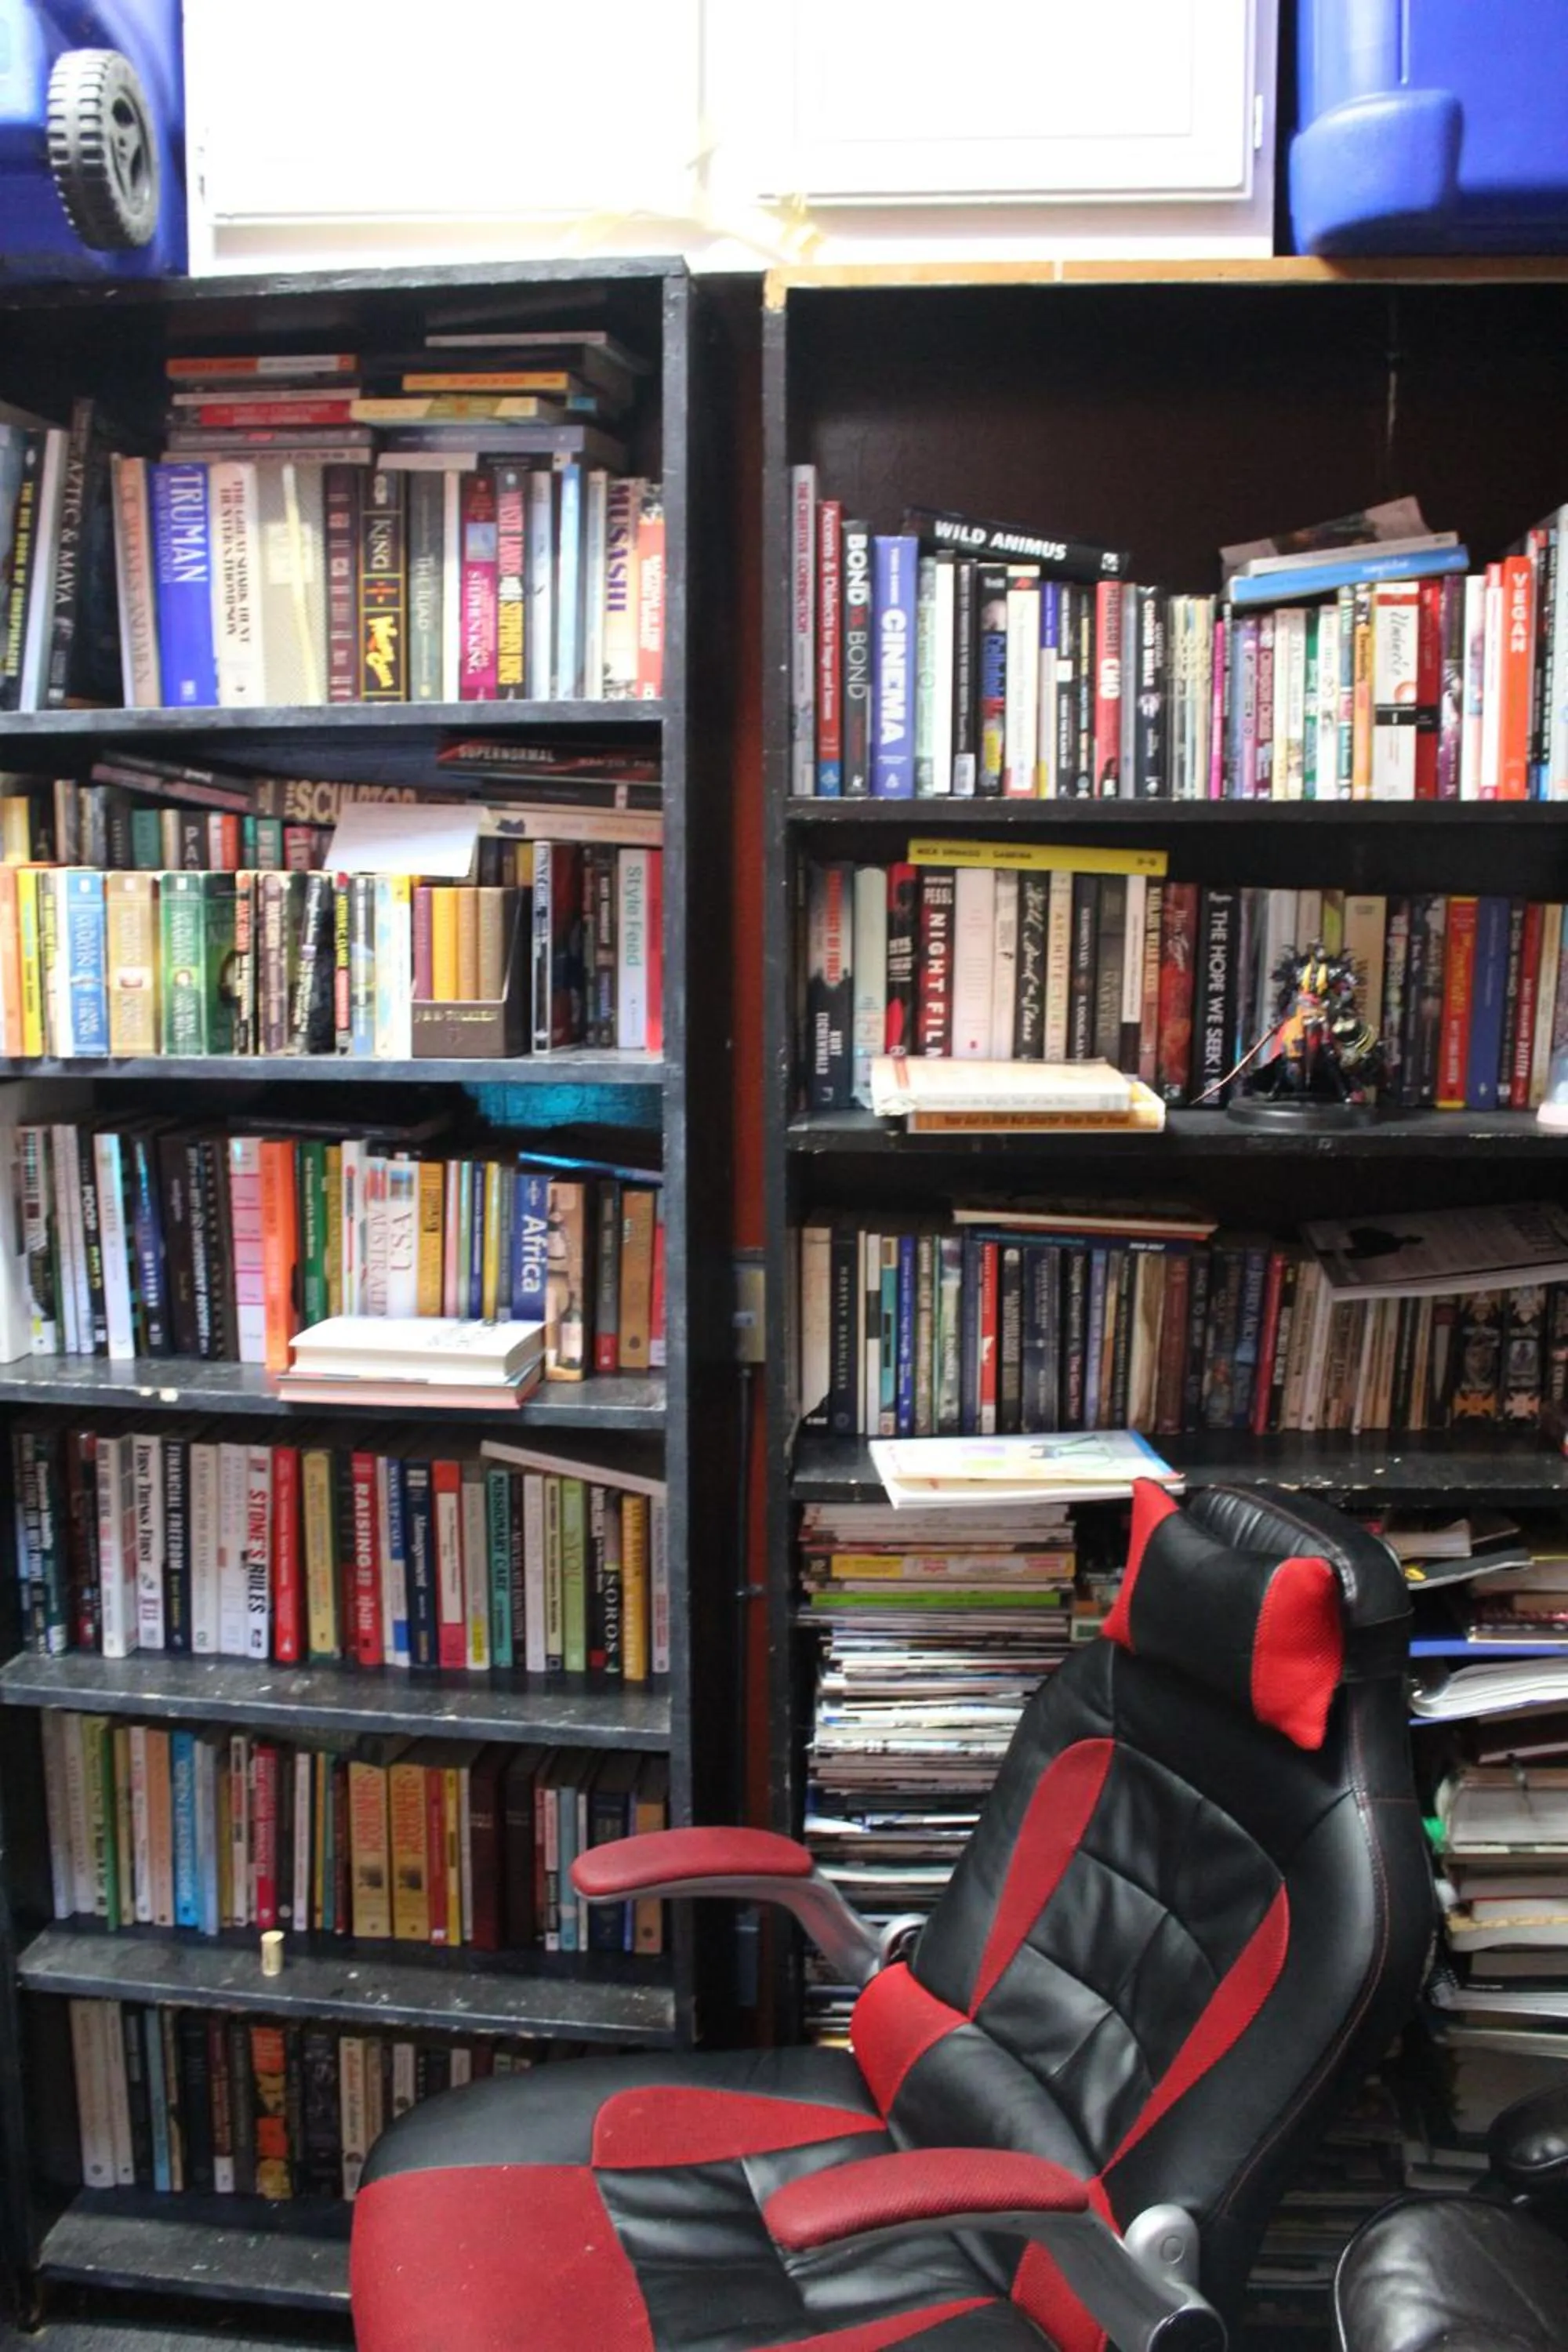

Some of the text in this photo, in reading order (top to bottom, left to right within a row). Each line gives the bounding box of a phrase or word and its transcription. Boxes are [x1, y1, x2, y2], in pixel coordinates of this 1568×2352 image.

[20, 508, 31, 528] BIG
[21, 482, 34, 503] THE
[169, 472, 207, 583] TRUMAN
[15, 533, 31, 566] BOOK
[55, 459, 84, 604] AZTEC & MAYA
[220, 488, 237, 635] HUNTER THOMPSON
[233, 481, 251, 644] THE GREAT SHARK HUNT
[499, 492, 523, 575] WASTE LANDS
[607, 485, 631, 612] MUSASHI
[797, 481, 808, 633] THE CREATIVE CONNECTION
[823, 507, 837, 557] Accents
[824, 561, 836, 572] &
[935, 521, 1067, 561] WILD ANIMUS
[14, 569, 27, 584] OF
[416, 556, 435, 630] THE ILIAD
[823, 576, 837, 627] Dialects
[848, 534, 868, 605] BOND
[466, 571, 483, 674] STEPHEN KING
[499, 602, 523, 684] STEPHEN KING
[1142, 600, 1155, 687] CHORD BIBLE
[1511, 572, 1528, 653] VEGAN
[822, 644, 833, 669] Stage
[824, 671, 833, 688] and
[848, 630, 867, 700] BOND
[880, 608, 907, 746] CINEMA
[1100, 659, 1120, 699] CHO
[459, 745, 556, 763] SUPERNORMAL
[624, 866, 643, 967] Style Feed
[827, 938, 841, 950] OF
[1146, 886, 1161, 929] NAVAJOS
[826, 952, 841, 985] FOOLS
[927, 912, 947, 993] NIGHT
[1146, 931, 1160, 961] WEAR
[1205, 910, 1228, 1066] THE HOPE WE SEEK
[815, 1011, 829, 1076] EICHENWALD
[829, 1029, 843, 1057] KURT
[1515, 1041, 1530, 1078] DEXTER
[82, 1185, 101, 1290] POOP GOLD
[389, 1211, 412, 1272] USA
[521, 1214, 548, 1294] Africa
[837, 1265, 849, 1390] MOSTLY HARMLESS
[1070, 1256, 1083, 1338] Douglas Coupland
[1245, 1270, 1264, 1312] JEFFREY
[945, 1338, 956, 1380] RUNNER
[1069, 1374, 1079, 1396] Gum
[1071, 1355, 1080, 1372] The
[136, 1444, 154, 1564] FIRST THINGS FIRST
[167, 1445, 184, 1569] FINANCIAL FREEDOM
[389, 1466, 399, 1498] WAKE
[248, 1490, 267, 1614] STONE'S RULES
[355, 1483, 371, 1568] RAISING
[411, 1513, 427, 1588] Management
[491, 1475, 510, 1592] MISSIONARY CARE
[604, 1574, 619, 1653] SOROS
[176, 1808, 191, 1900] LEADERSHIP
